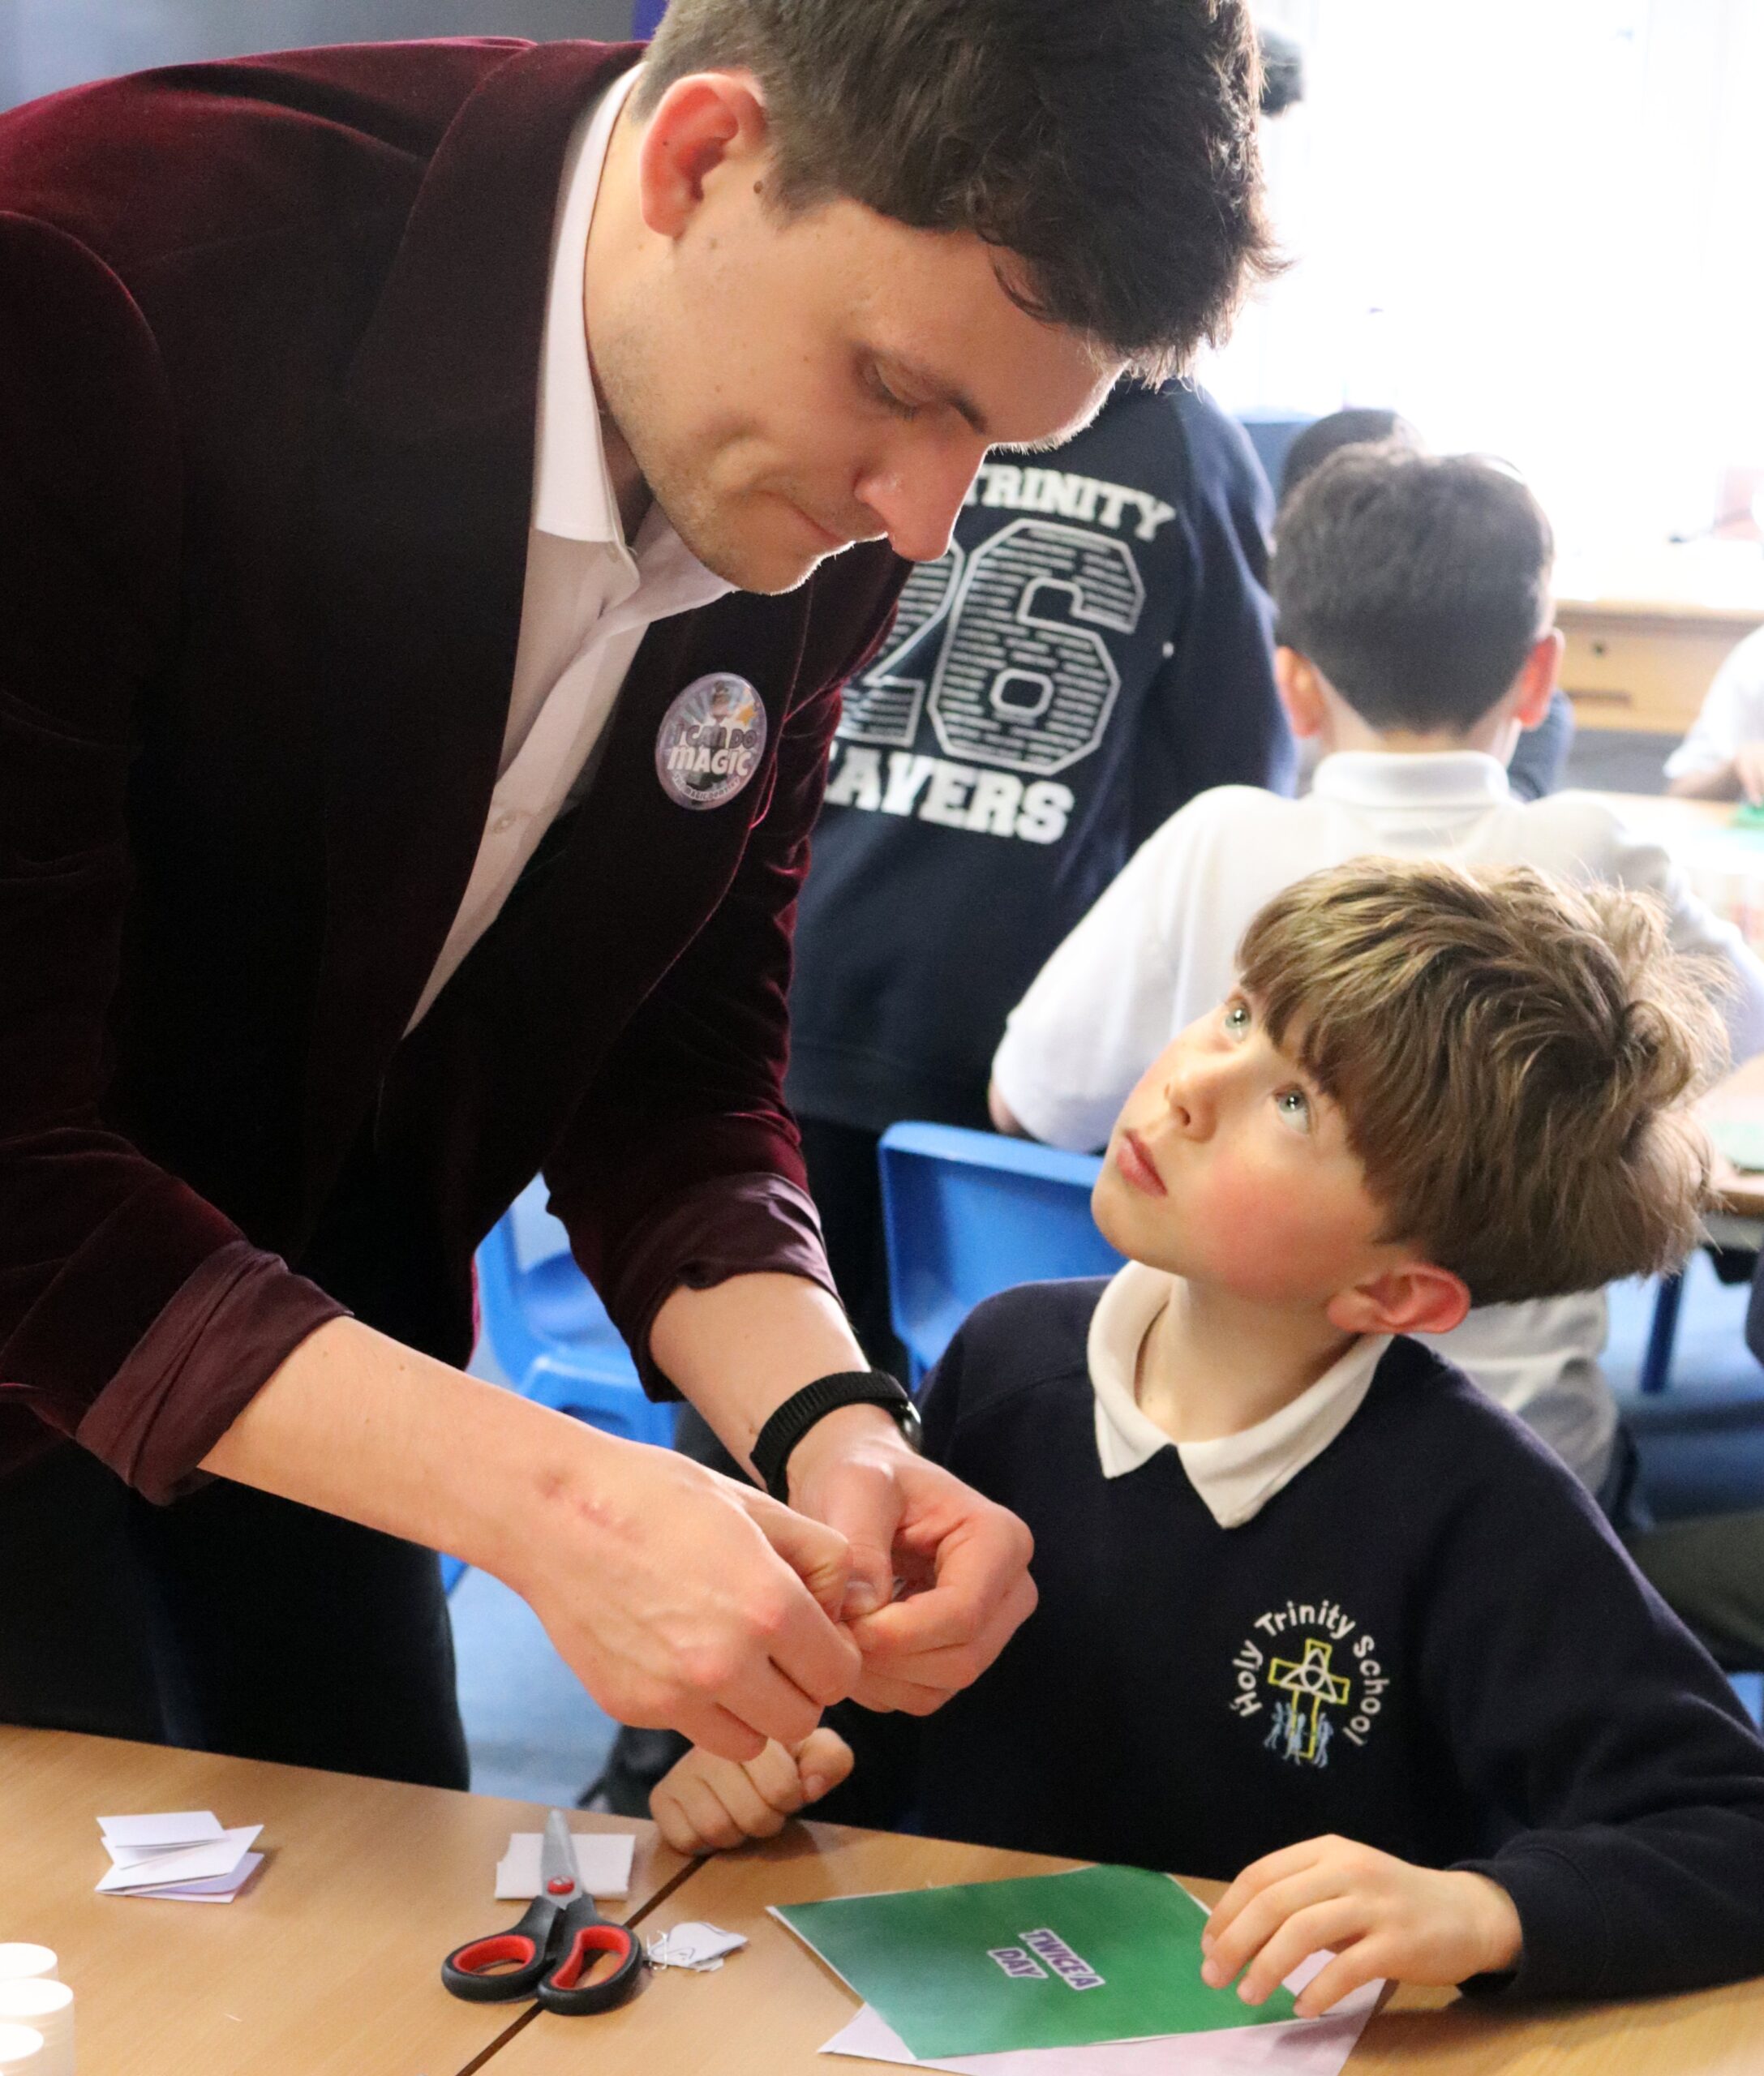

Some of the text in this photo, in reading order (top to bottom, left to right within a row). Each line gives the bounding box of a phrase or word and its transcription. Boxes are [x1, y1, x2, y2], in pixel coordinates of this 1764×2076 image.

[834, 517, 1147, 776] 26
[667, 745, 753, 776] MAGIC
[686, 724, 727, 749] CAN
[729, 727, 758, 750] DO
[824, 740, 1075, 845] AVERS
[1232, 1599, 1390, 1746] Holy Trinity School
[991, 1949, 1045, 1977] DAY
[1023, 1928, 1101, 1988] TWICE A
